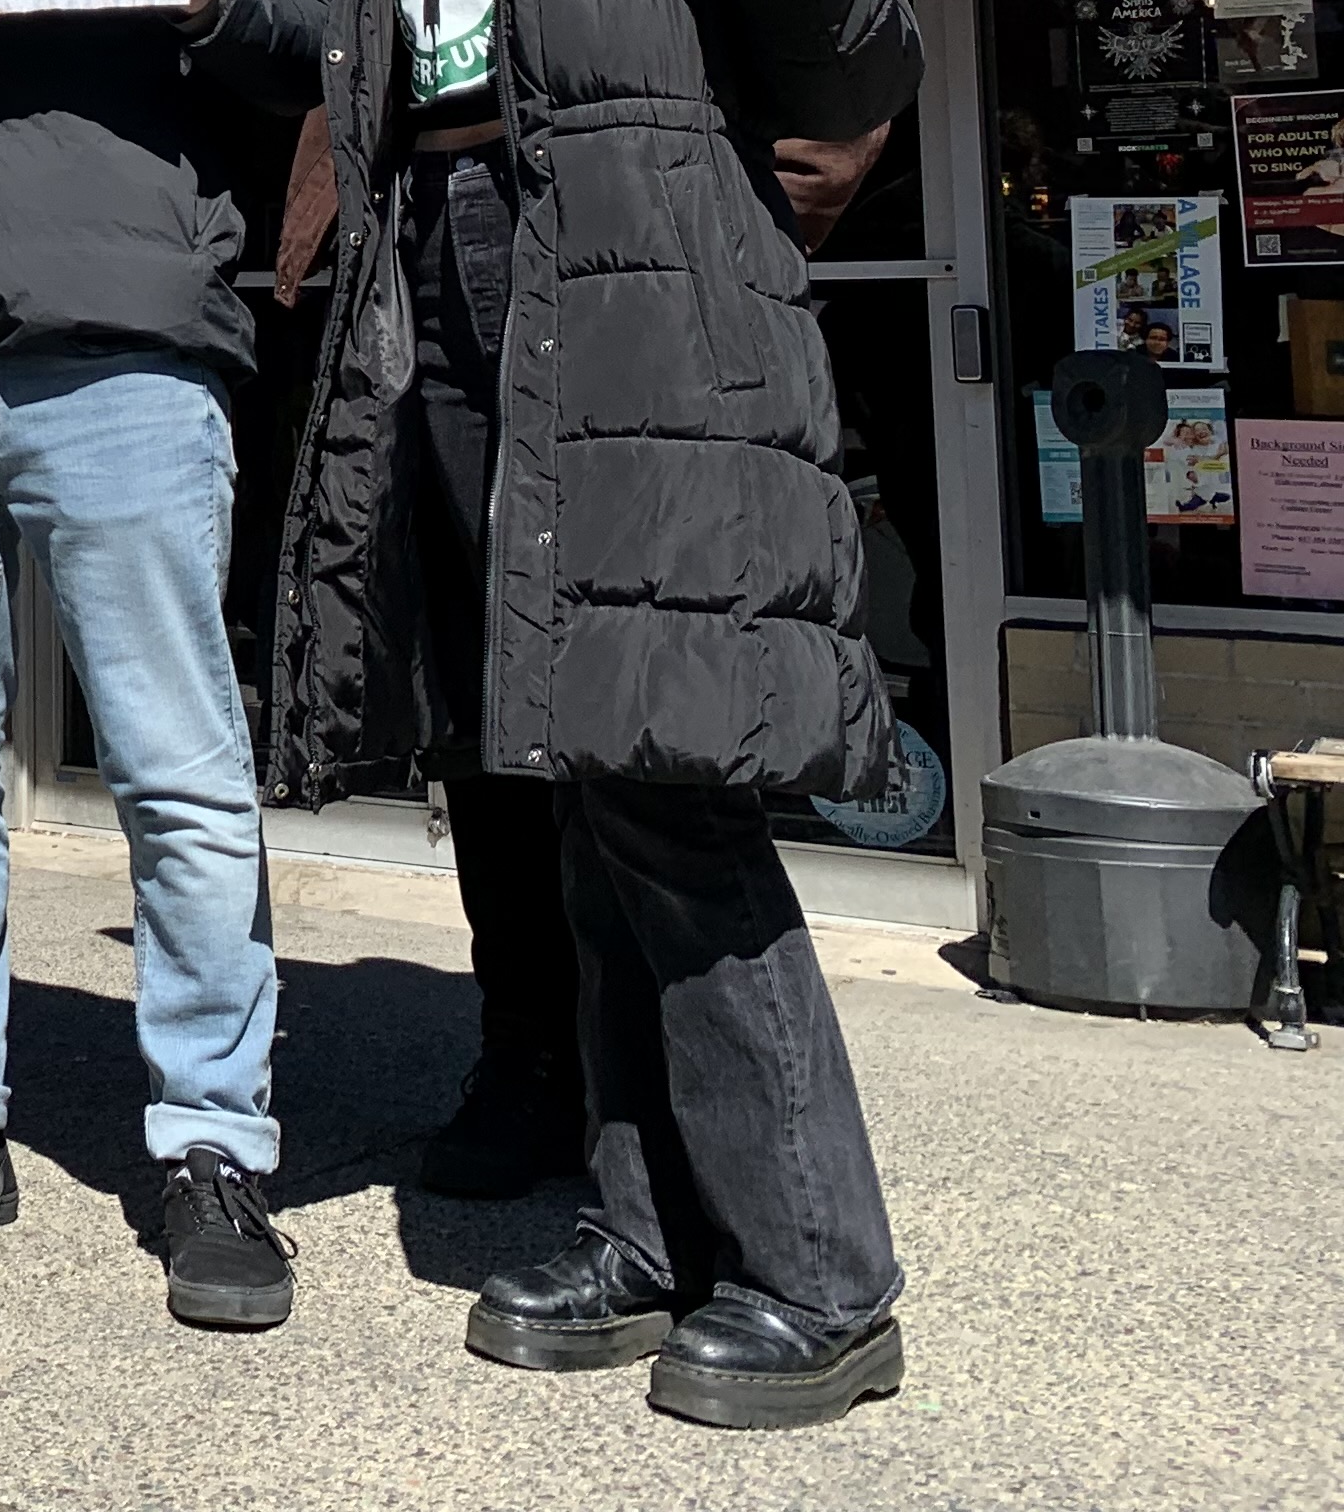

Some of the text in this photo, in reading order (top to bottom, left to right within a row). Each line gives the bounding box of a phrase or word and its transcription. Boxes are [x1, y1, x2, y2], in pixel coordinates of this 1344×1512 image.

[1111, 6, 1162, 19] AMERICA
[1247, 130, 1329, 144] FOR ADULTS
[1249, 145, 1326, 159] WHO WANT
[1249, 161, 1303, 174] TO SING
[1178, 199, 1198, 214] A
[1179, 220, 1201, 309] VILLAGE
[1094, 287, 1109, 337] TAKES
[1250, 438, 1325, 451] Background
[1282, 455, 1329, 467] Needed
